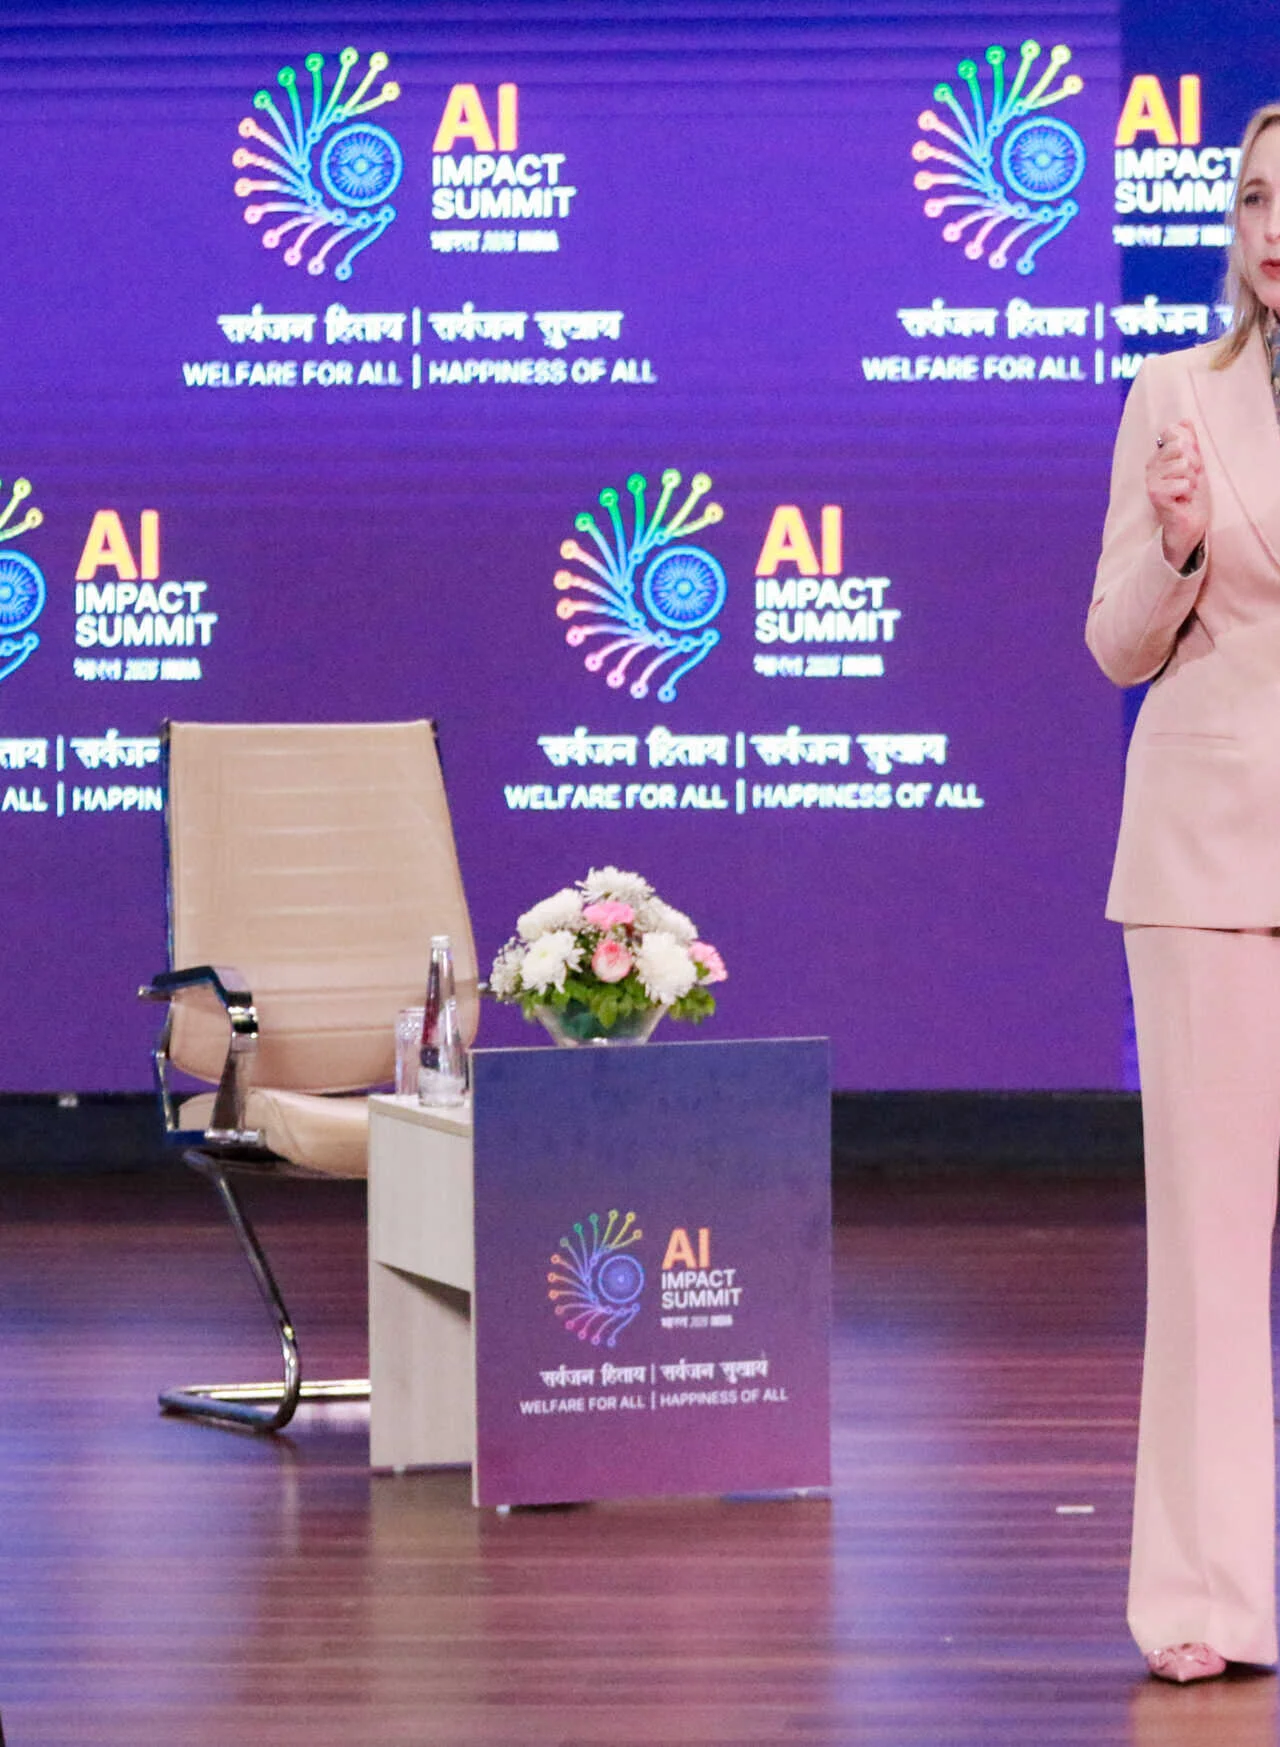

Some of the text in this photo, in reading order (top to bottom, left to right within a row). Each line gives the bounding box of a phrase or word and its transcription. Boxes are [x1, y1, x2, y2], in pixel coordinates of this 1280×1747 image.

[431, 81, 519, 151] AI
[1113, 73, 1201, 146] AI
[432, 153, 566, 185] IMPACT
[1114, 147, 1242, 180] IMPACT
[431, 185, 577, 219] SUMMIT
[1114, 180, 1234, 214] SUMM
[182, 357, 657, 386] WELFARE FOR ALL HAPPINESS OF ALL
[861, 355, 980, 381] WELFARE
[983, 354, 1037, 381] FOR
[1038, 355, 1086, 380] ALL
[74, 508, 160, 580] AI
[754, 503, 843, 575] AI
[75, 581, 208, 612] IMPACT
[755, 575, 891, 608] IMPACT
[75, 612, 219, 647] SUMMIT
[754, 608, 902, 643] SUMMIT
[1, 785, 163, 811] ALL HAPPIN
[503, 782, 985, 809] WELFARE FOR ALL HAPPINESS OF ALL
[661, 1227, 711, 1270] AI
[661, 1269, 736, 1289] IMPACT
[661, 1288, 742, 1309] SUMMIT
[520, 1387, 788, 1415] WELFARE FOR ALL HAPPINESS OF ALL
